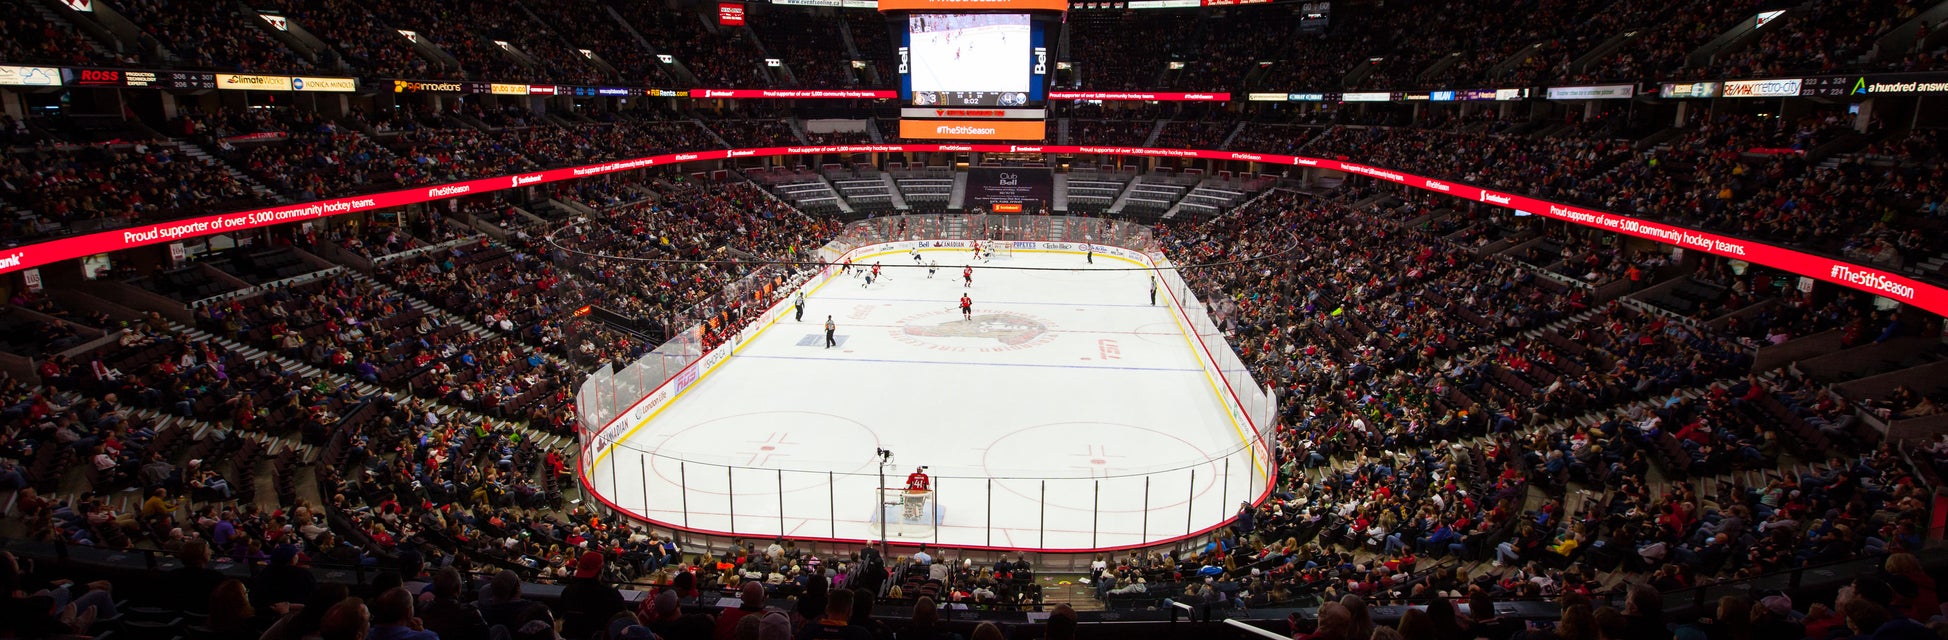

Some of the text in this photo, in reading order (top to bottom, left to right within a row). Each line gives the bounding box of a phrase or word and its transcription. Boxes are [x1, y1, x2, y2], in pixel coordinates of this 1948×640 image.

[899, 47, 908, 73] Bell
[1034, 47, 1047, 74] Bell
[81, 69, 119, 81] ROSS
[231, 75, 284, 85] ClimateWorks
[1724, 81, 1800, 95] RE/MAX metro-city
[1868, 84, 1876, 92] a
[1875, 82, 1916, 92] hundred
[937, 126, 995, 134] #The5thSeason
[518, 174, 543, 184] Scotiabank
[428, 184, 469, 198] #The5thSeason
[1485, 192, 1511, 204] Scotiabank
[124, 198, 375, 243] Proud supporter of over 5,000 community hockey teams.
[1550, 205, 1746, 256] Proud supporter of over 5,000 community hockey teams.
[1830, 264, 1914, 299] #The5thSeason
[642, 396, 660, 414] London
[913, 479, 923, 488] 41
